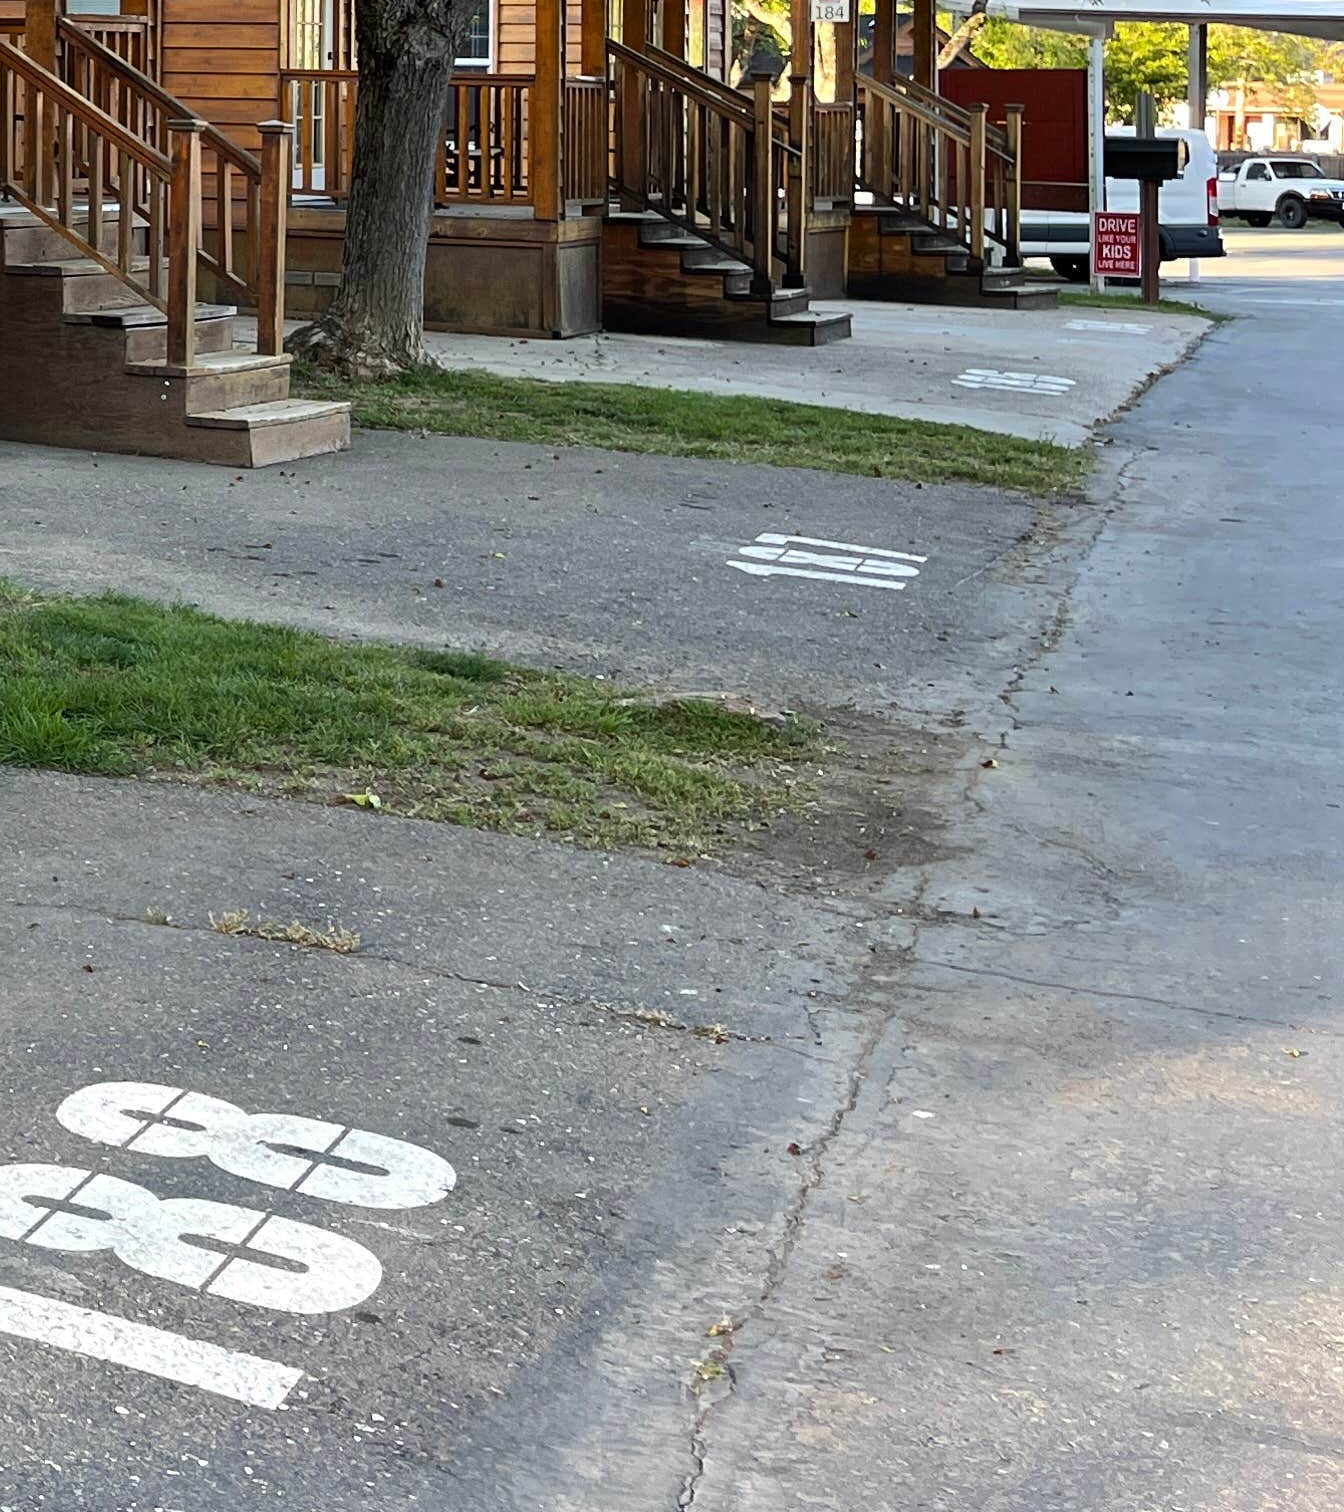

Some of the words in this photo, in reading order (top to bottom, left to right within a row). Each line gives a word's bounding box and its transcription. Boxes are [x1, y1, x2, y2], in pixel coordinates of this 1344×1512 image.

[815, 6, 844, 20] 184
[1098, 218, 1136, 233] DRIVE
[1098, 234, 1114, 243] LIKE
[1115, 235, 1136, 244] YOUR
[1102, 244, 1132, 259] KIDS
[1098, 260, 1114, 269] LIVE
[1115, 261, 1135, 270] HERE
[725, 532, 928, 590] 187
